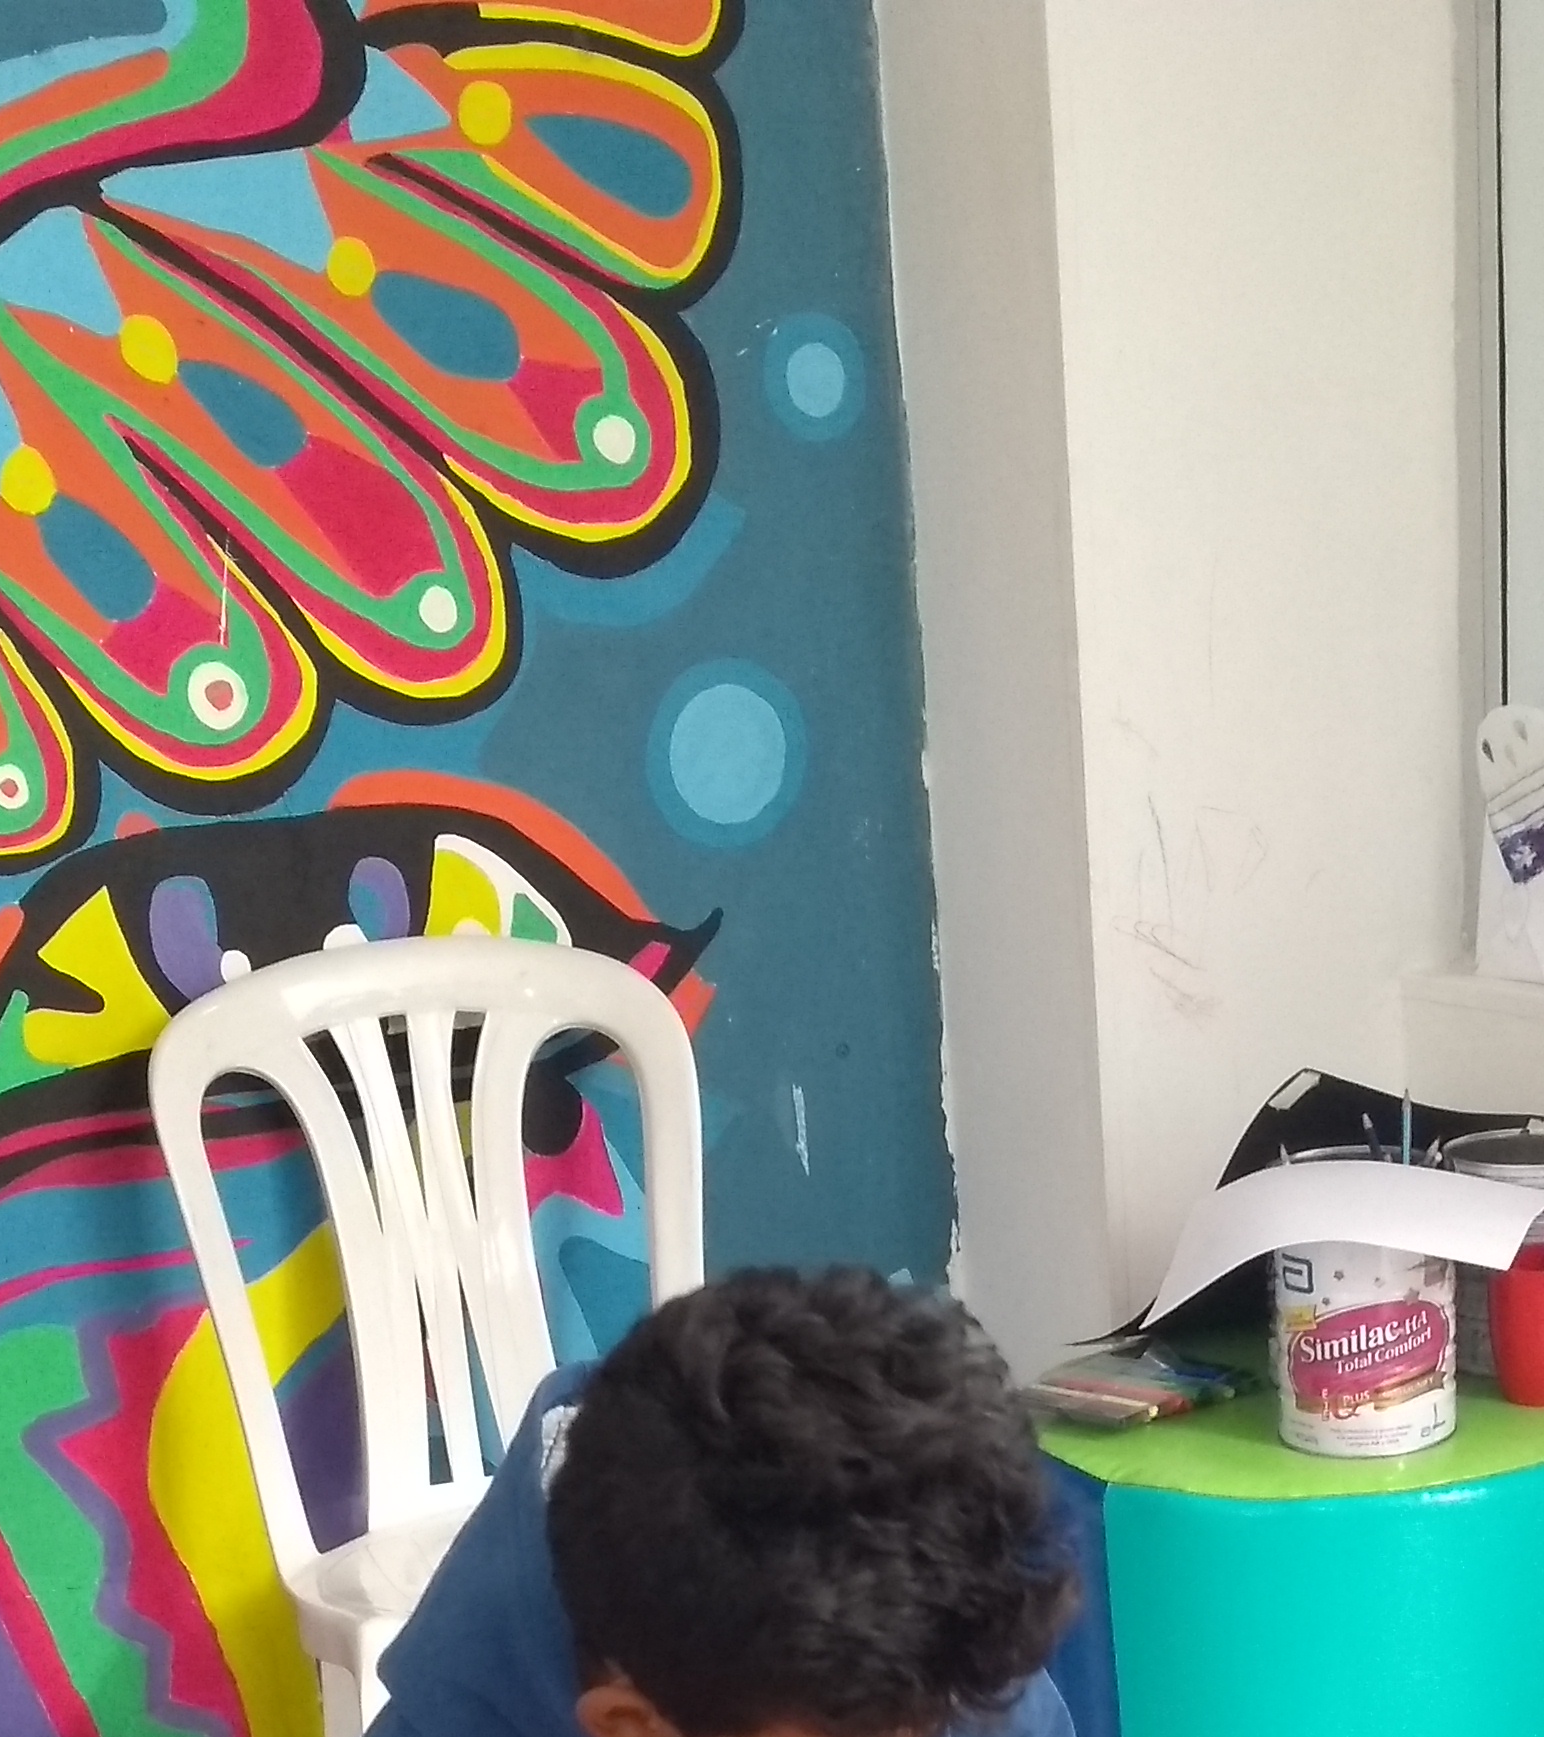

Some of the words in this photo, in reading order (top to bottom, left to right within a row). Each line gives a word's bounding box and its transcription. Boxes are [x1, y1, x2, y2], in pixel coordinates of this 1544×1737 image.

[1300, 1320, 1400, 1363] Similac
[1334, 1353, 1373, 1375] Total
[1374, 1327, 1432, 1363] Comfort
[1342, 1389, 1370, 1407] PLUS
